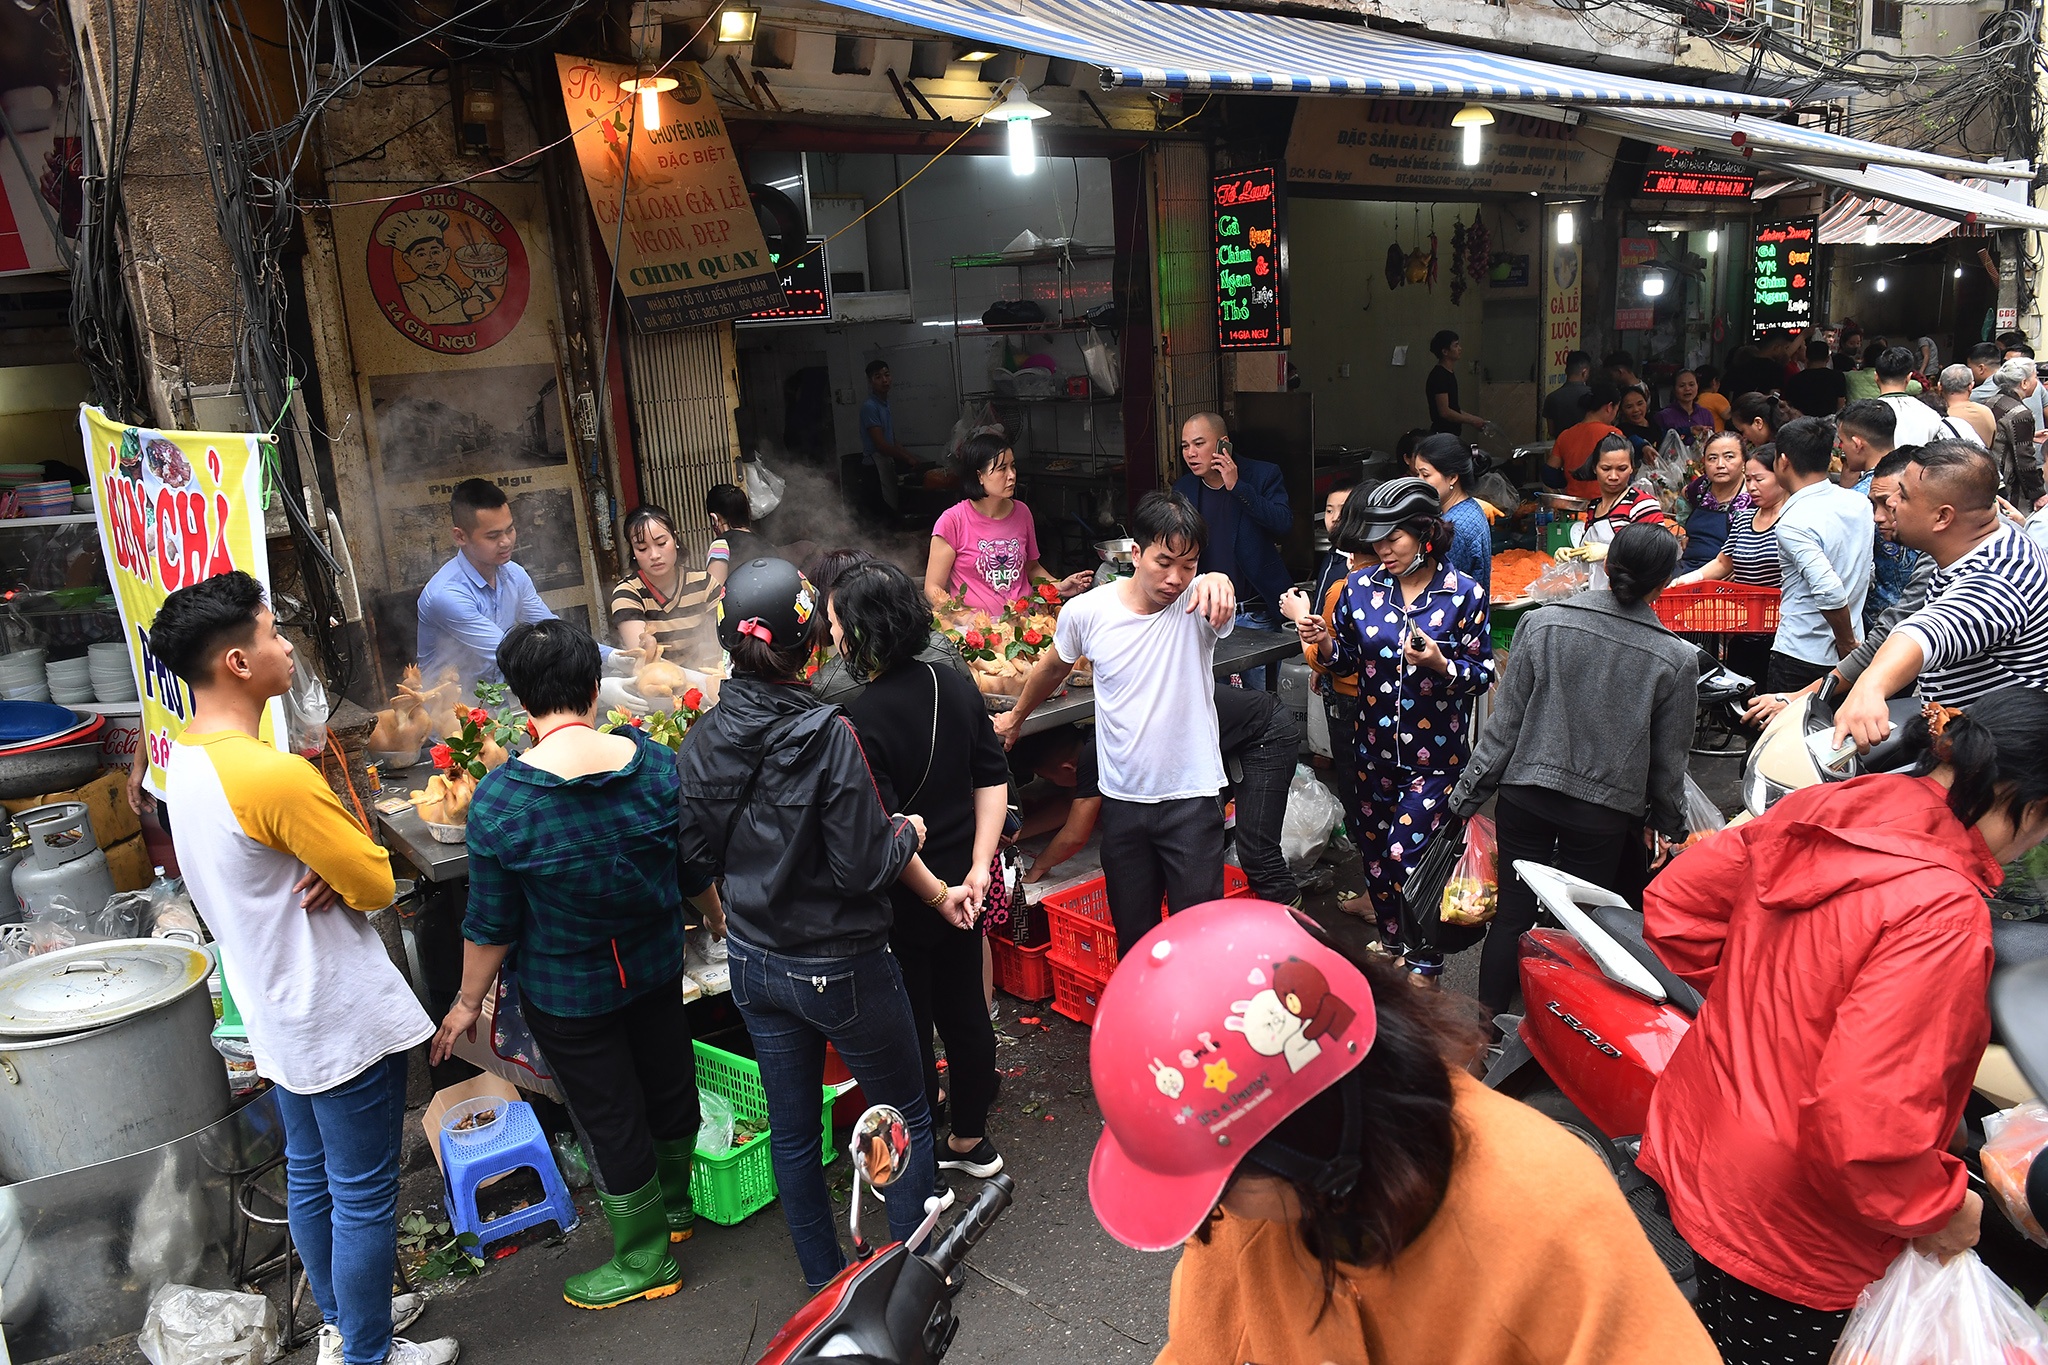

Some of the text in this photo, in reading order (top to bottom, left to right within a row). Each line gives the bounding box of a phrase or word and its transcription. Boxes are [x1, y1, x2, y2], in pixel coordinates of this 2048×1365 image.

[648, 119, 721, 145] CHUYÊN BÁN
[657, 146, 726, 169] ĐẶC BIỆT
[597, 175, 747, 225] CÁC LOẠI GÀ LỄ
[1239, 180, 1271, 201] Lan
[693, 219, 731, 248] ĐẸP
[1218, 215, 1241, 236] Gà
[1758, 225, 1811, 243] Hoàng Dung
[1218, 244, 1252, 265] Chim
[1757, 243, 1776, 257] Gà
[629, 257, 693, 287] CHIM
[700, 250, 760, 280] QUAY
[1255, 255, 1270, 276] &
[1757, 260, 1777, 275] Vịt
[1220, 269, 1252, 296] Ngan
[1756, 275, 1787, 289] Chim
[1791, 273, 1806, 288] &
[705, 291, 711, 301] 1
[1550, 287, 1580, 314] GÀ LỄ
[1756, 290, 1789, 305] Ngan
[1220, 298, 1250, 321] Thỏ
[386, 301, 476, 349] 14 GIA NGƯ
[1551, 316, 1578, 342] LUỘC
[1554, 345, 1573, 366] XÔ
[985, 569, 1020, 582] KENZO
[1545, 1001, 1622, 1058] LEAD
